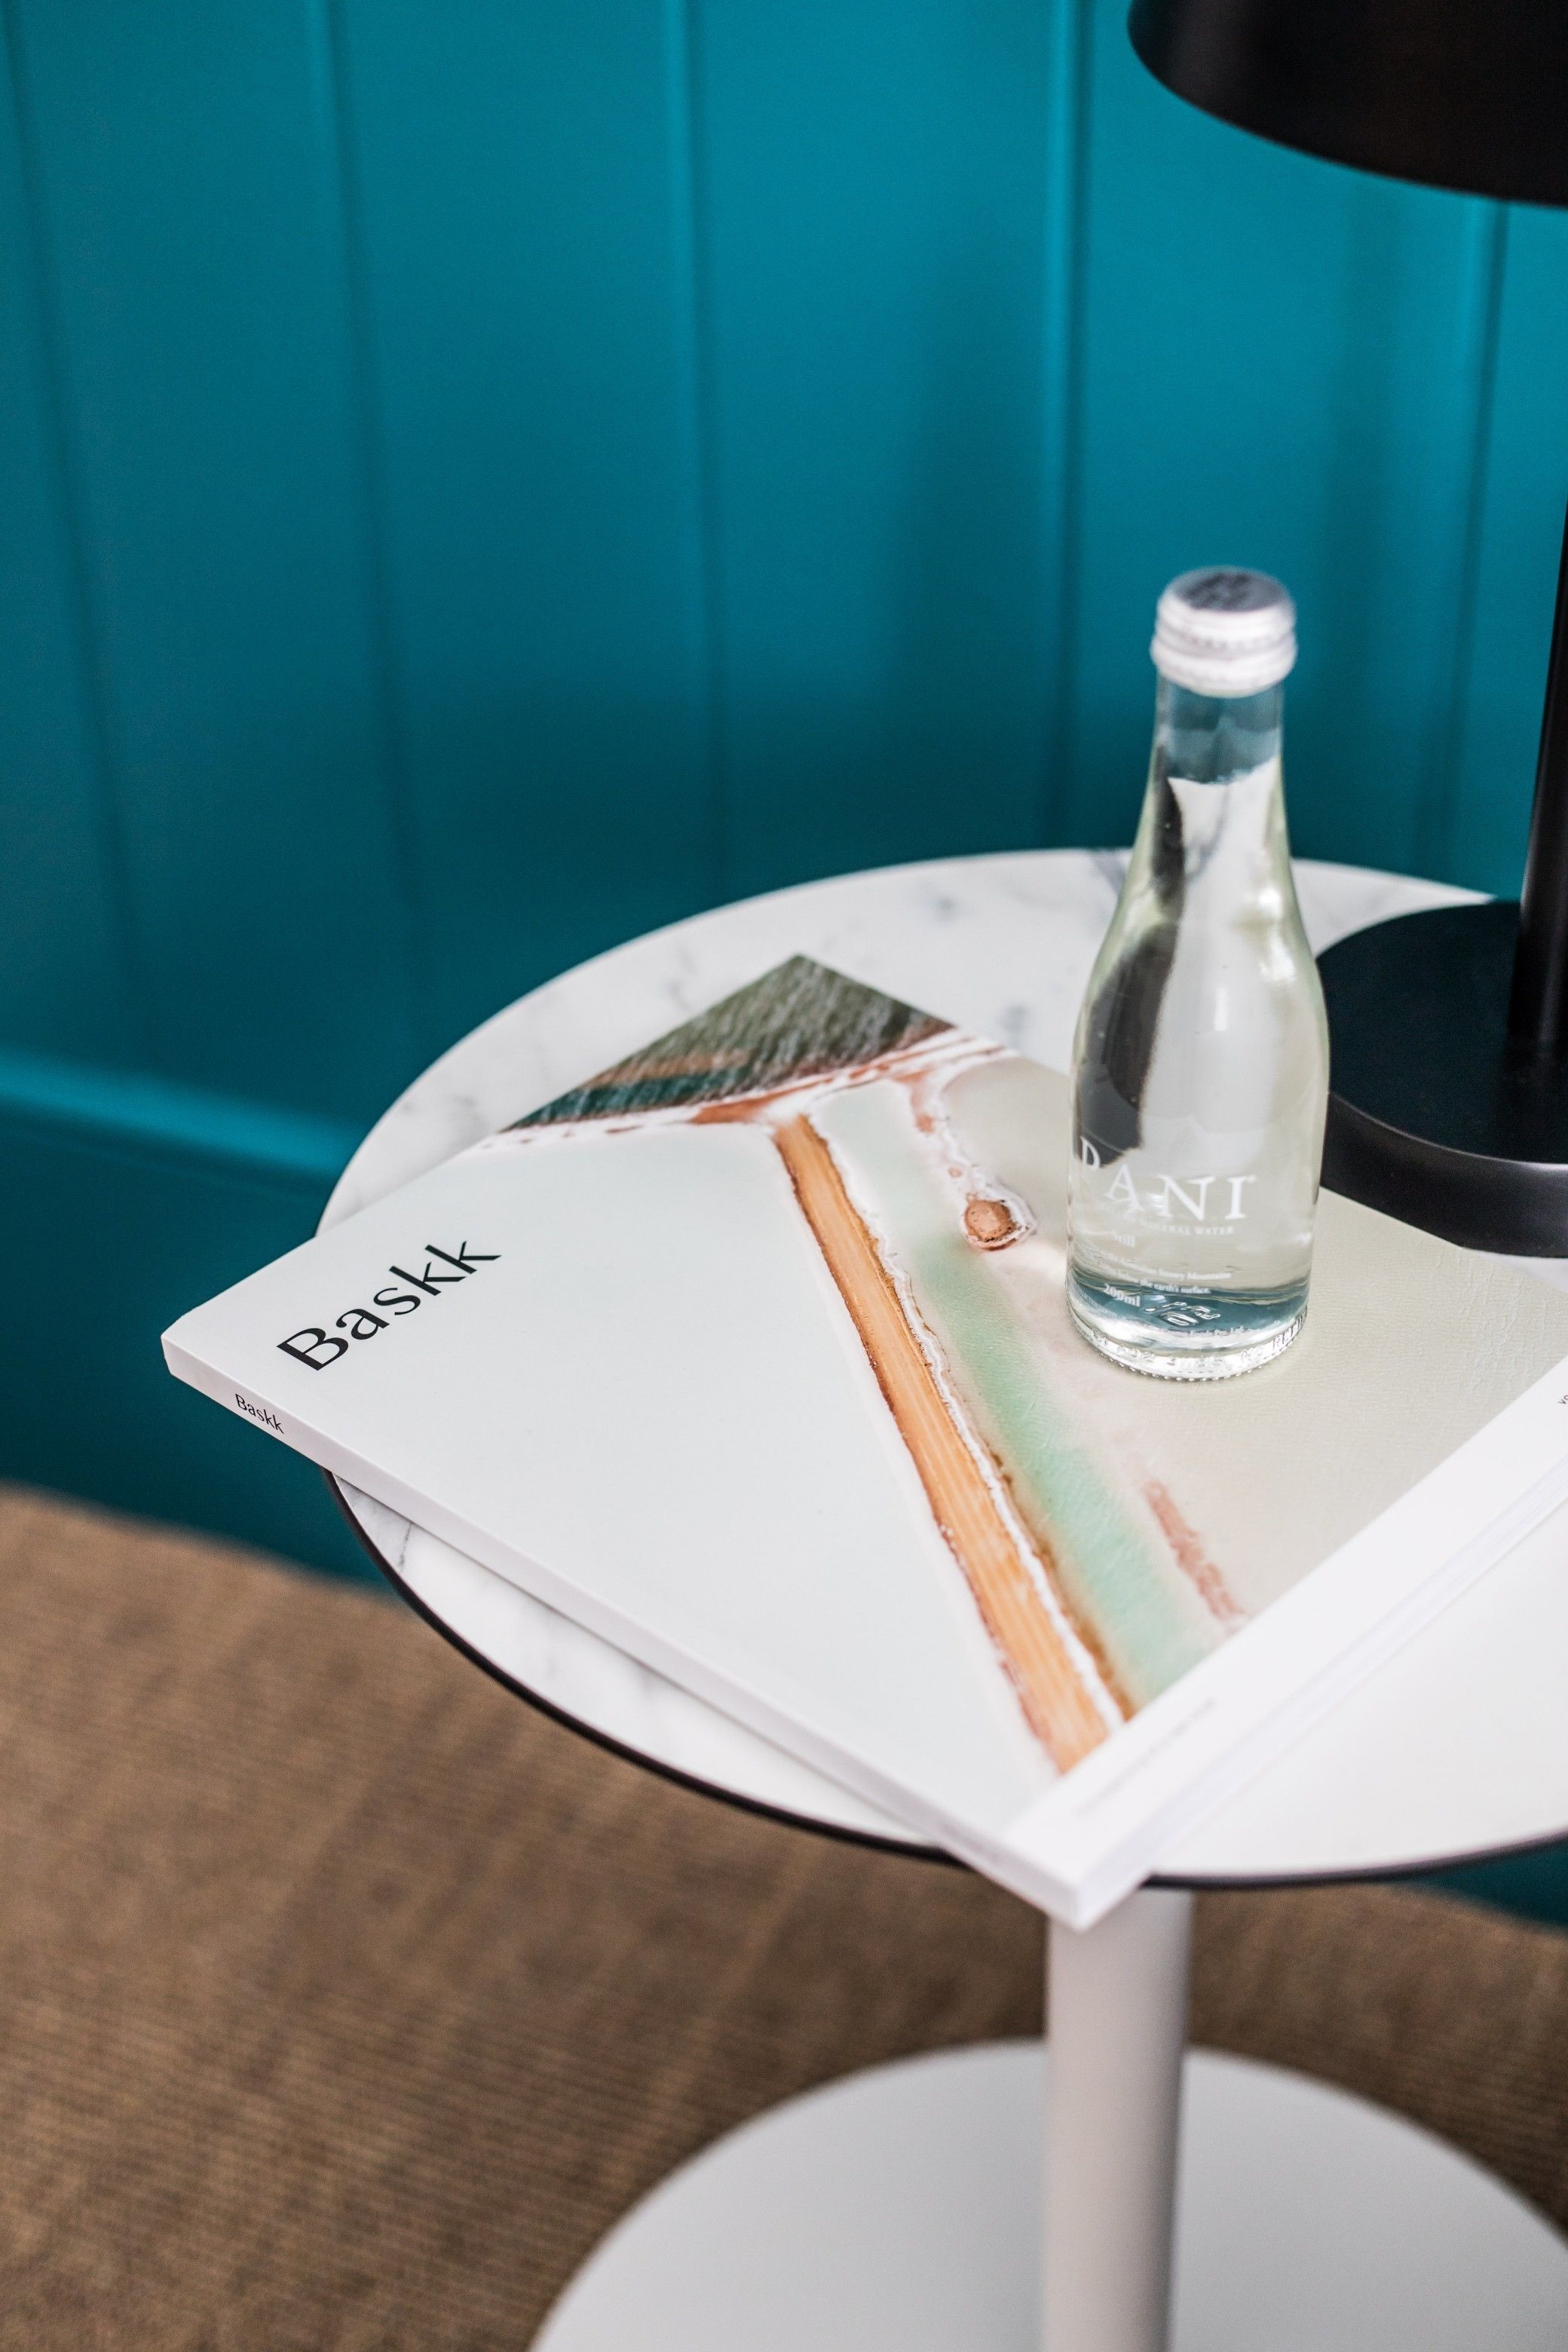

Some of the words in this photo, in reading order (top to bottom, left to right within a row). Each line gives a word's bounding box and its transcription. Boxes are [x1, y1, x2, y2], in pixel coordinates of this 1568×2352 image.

[277, 1241, 502, 1370] Baskk
[1104, 1283, 1140, 1307] 200ml
[235, 1393, 284, 1434] Baskk
